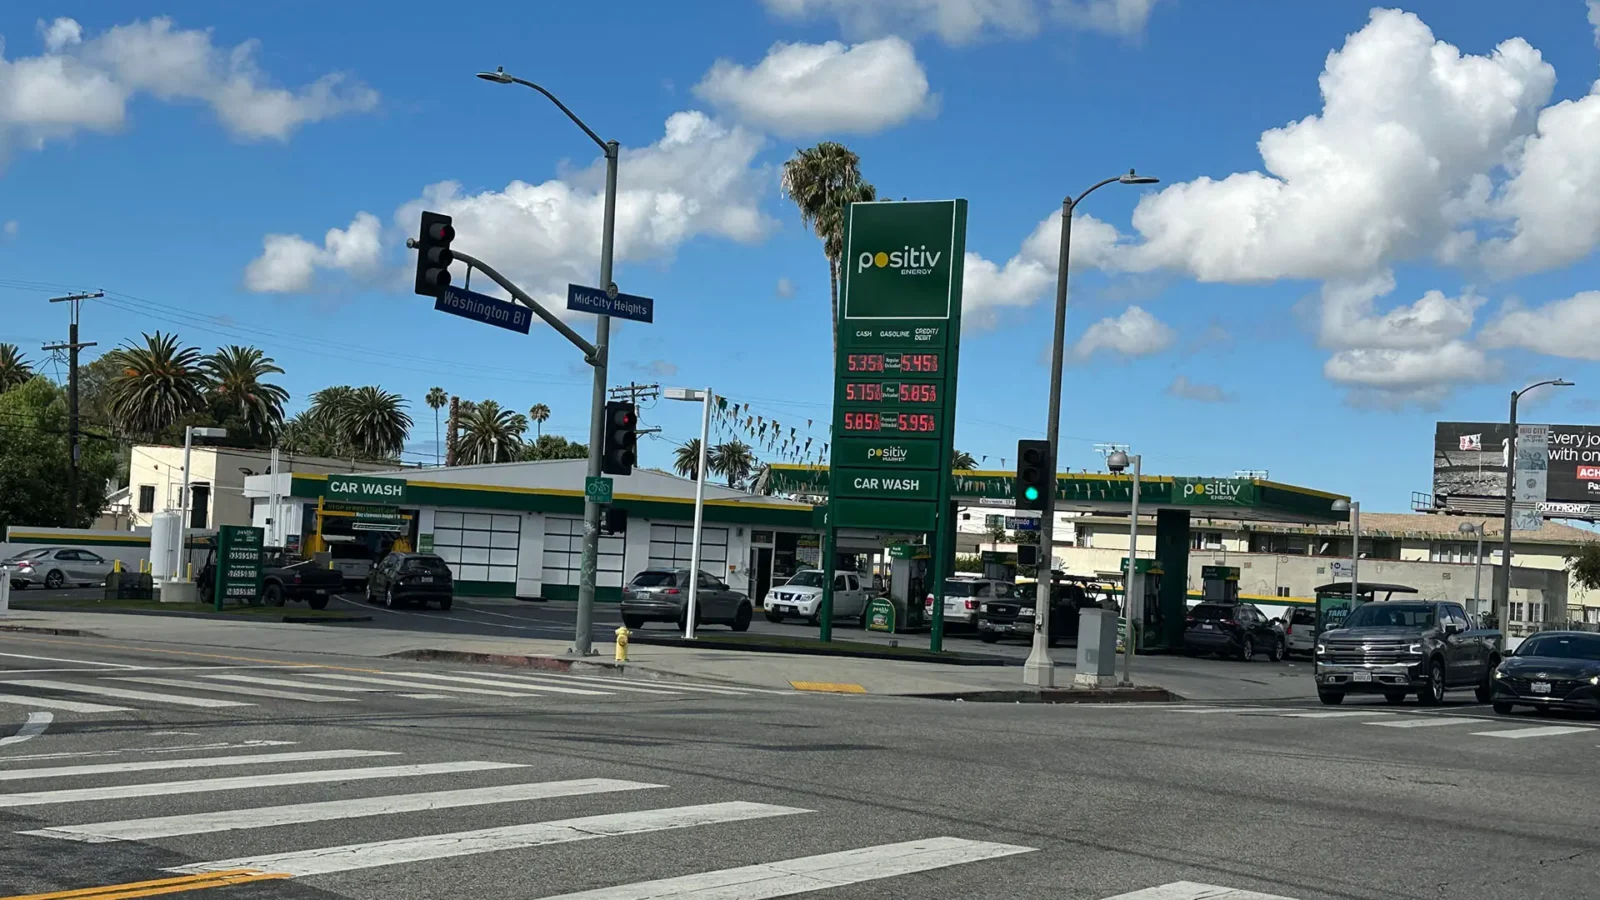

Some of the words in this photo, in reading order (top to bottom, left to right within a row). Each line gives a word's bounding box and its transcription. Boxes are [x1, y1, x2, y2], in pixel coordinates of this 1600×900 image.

[858, 245, 941, 273] positiv
[443, 290, 510, 321] Washington
[513, 310, 526, 326] Bl
[574, 292, 612, 311] Mid-City
[613, 300, 648, 315] Heights
[1548, 430, 1585, 448] Every
[868, 446, 908, 459] positiv
[1548, 447, 1579, 461] with
[330, 481, 358, 493] CAR
[361, 483, 402, 496] WASH
[854, 478, 879, 489] CAR
[882, 479, 920, 490] WASH
[1184, 481, 1241, 498] positiv
